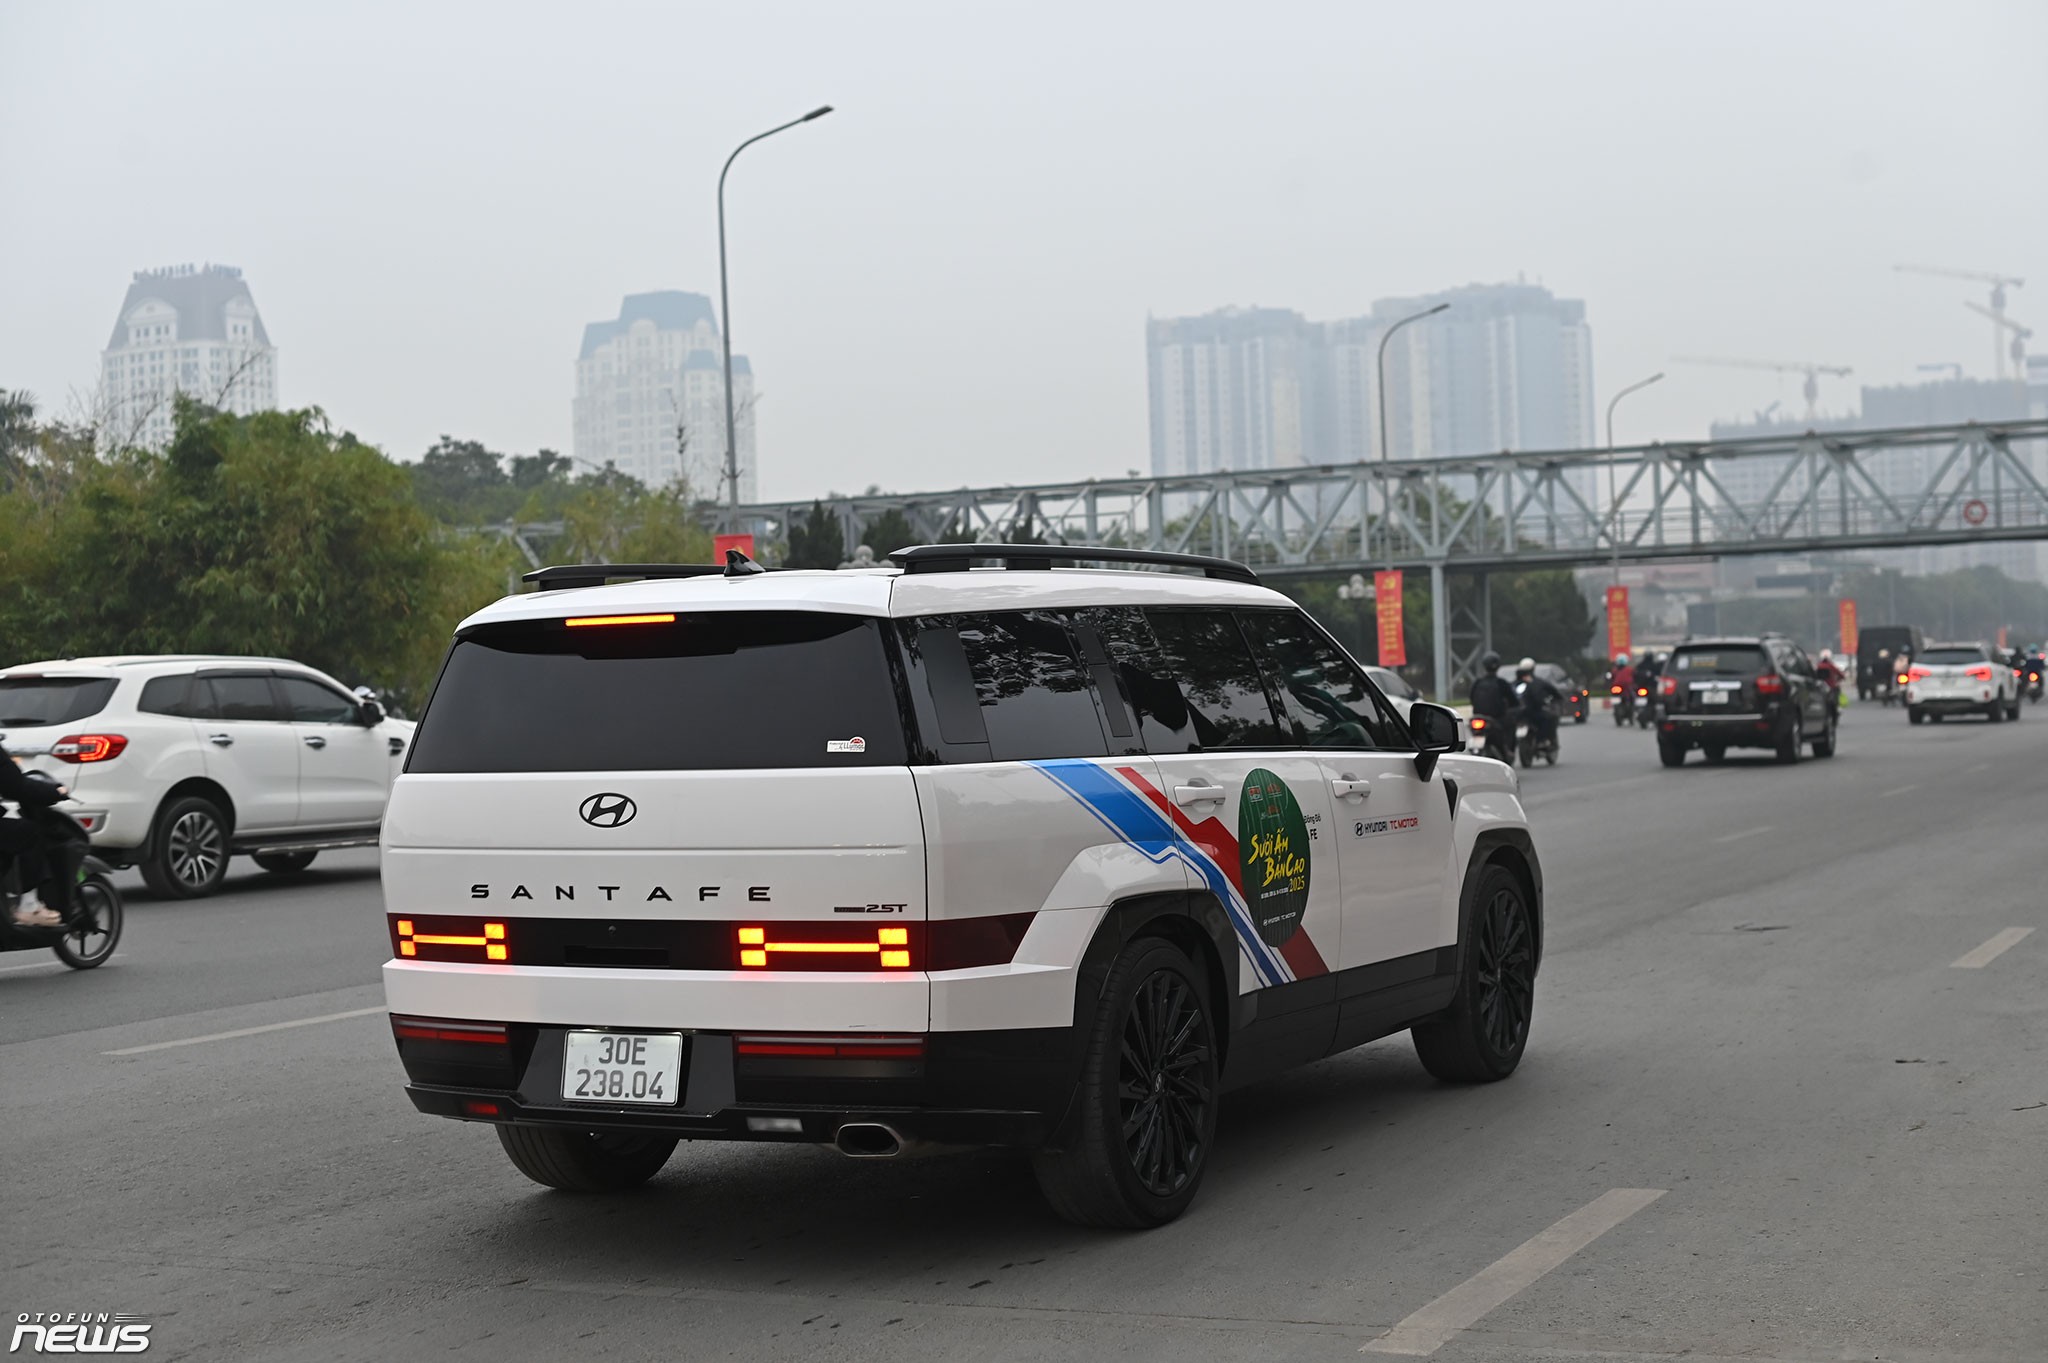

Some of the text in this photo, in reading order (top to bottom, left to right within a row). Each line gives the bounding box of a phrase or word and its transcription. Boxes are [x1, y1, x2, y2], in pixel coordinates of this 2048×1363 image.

[1310, 828, 1318, 840] FE
[1364, 820, 1388, 834] HYUNDAI
[1288, 875, 1305, 892] 2025
[598, 1036, 648, 1065] 30E
[575, 1068, 664, 1099] 238.04
